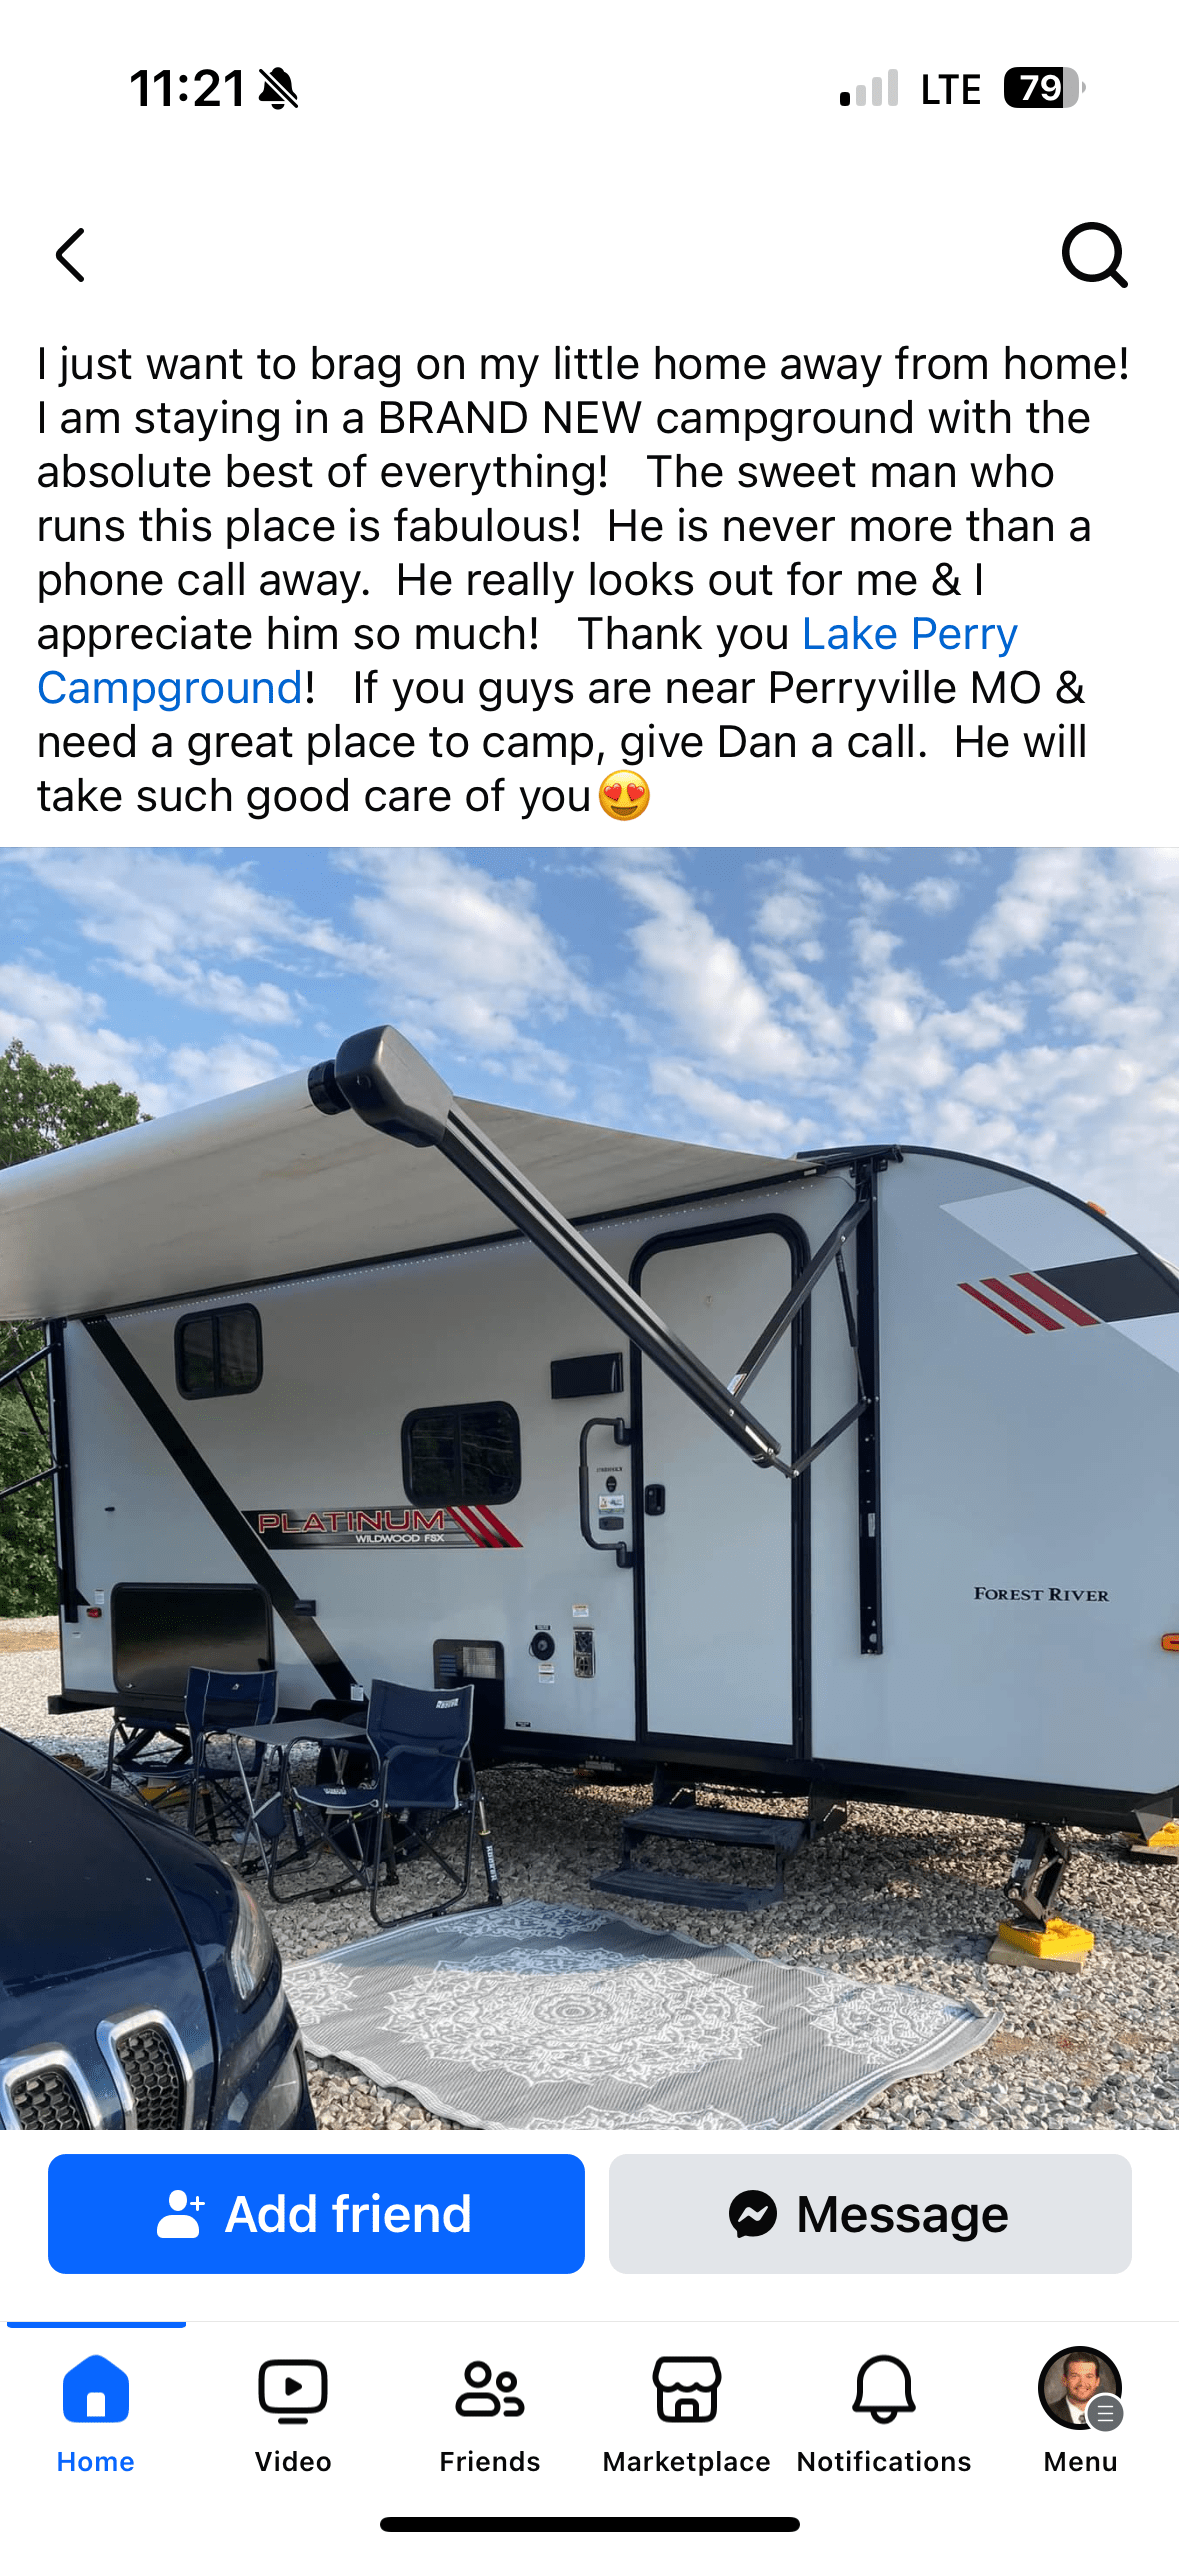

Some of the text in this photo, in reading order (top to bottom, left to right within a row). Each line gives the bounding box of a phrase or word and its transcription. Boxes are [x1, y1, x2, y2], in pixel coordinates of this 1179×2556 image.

[131, 69, 241, 106] 11:21
[923, 74, 1062, 104] LTE 79
[40, 345, 1127, 388] I just want to brag on my little home away from home!
[40, 399, 1090, 442] I am staying in a BRAND NEW campground with the
[38, 453, 1053, 496] absolute best of everything! The sweet man who
[39, 507, 1090, 549] runs this place is fabulous! He is never more than a
[39, 561, 981, 604] phone call away. He really looks out for me & I
[38, 615, 1018, 658] appreciate him so much! Thank you Lake Perry
[39, 669, 1085, 712] Campground! If you guys are near Perryville MO &
[39, 723, 1085, 766] need a great place to camp, give Dan a call. He will
[37, 777, 589, 820] take such good care of you
[258, 1509, 445, 1534] PLATINUM
[356, 1533, 445, 1543] WILDWOOD FSX
[974, 1586, 1110, 1602] FOREST RIVER
[225, 2193, 470, 2233] Add friend
[799, 2196, 1008, 2242] Message
[58, 2452, 134, 2471] Home
[255, 2450, 331, 2472] Video
[441, 2450, 540, 2472] Friends
[604, 2451, 770, 2476] Marketplace
[798, 2450, 971, 2472] Notifications
[1045, 2452, 1116, 2471] Menu
